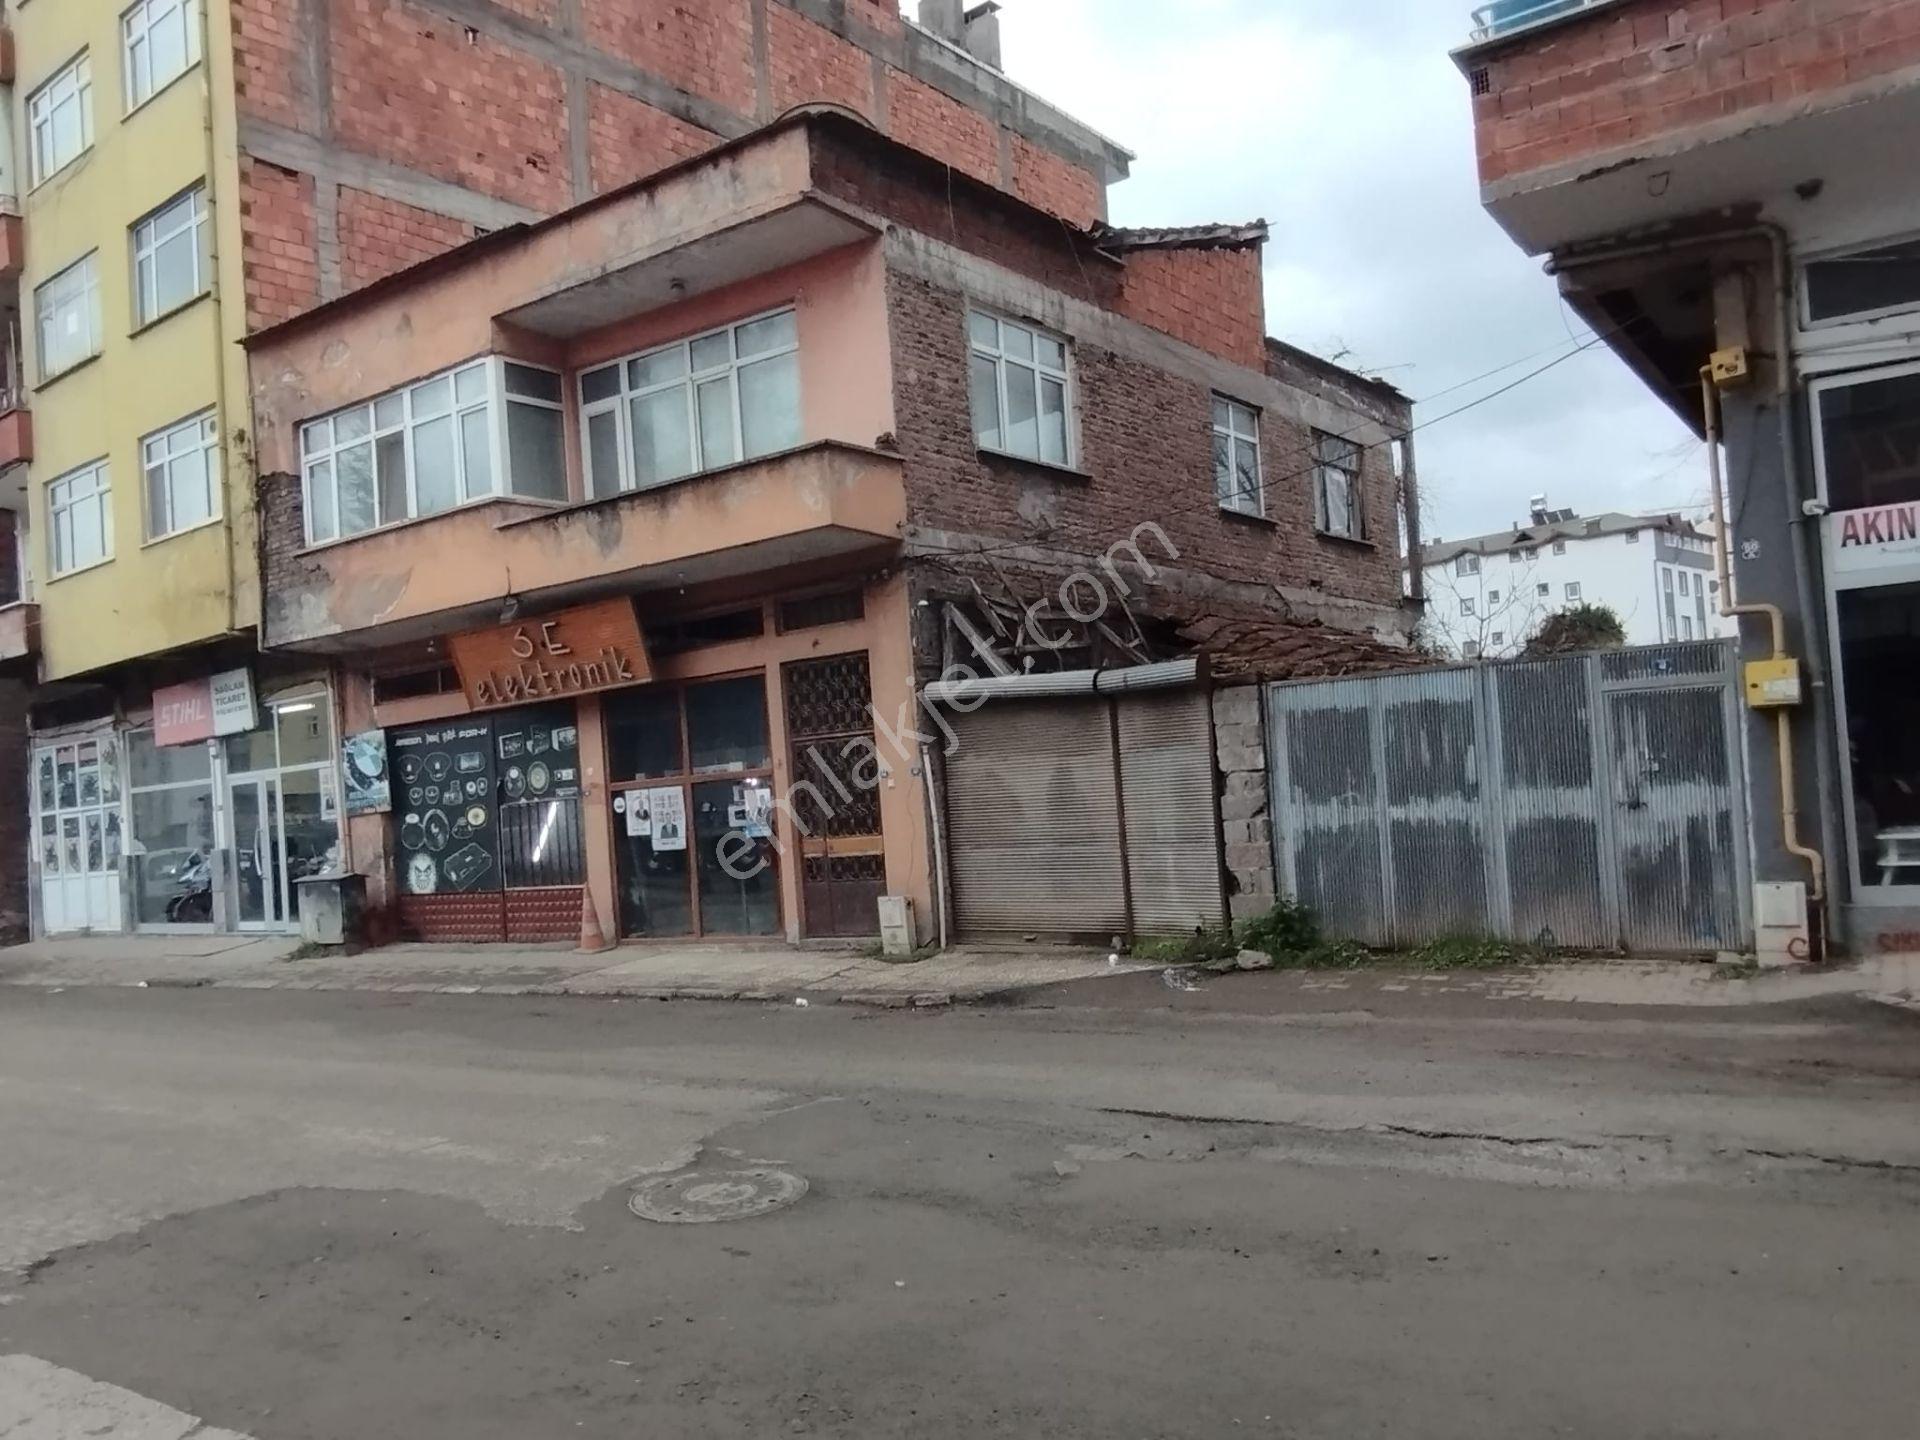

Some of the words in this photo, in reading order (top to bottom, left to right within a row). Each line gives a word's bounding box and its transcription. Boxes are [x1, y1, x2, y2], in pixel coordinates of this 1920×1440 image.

[1841, 507, 1916, 548] AKIN
[512, 622, 571, 658] SE
[477, 646, 632, 702] elektronik
[161, 698, 206, 728] STIHL
